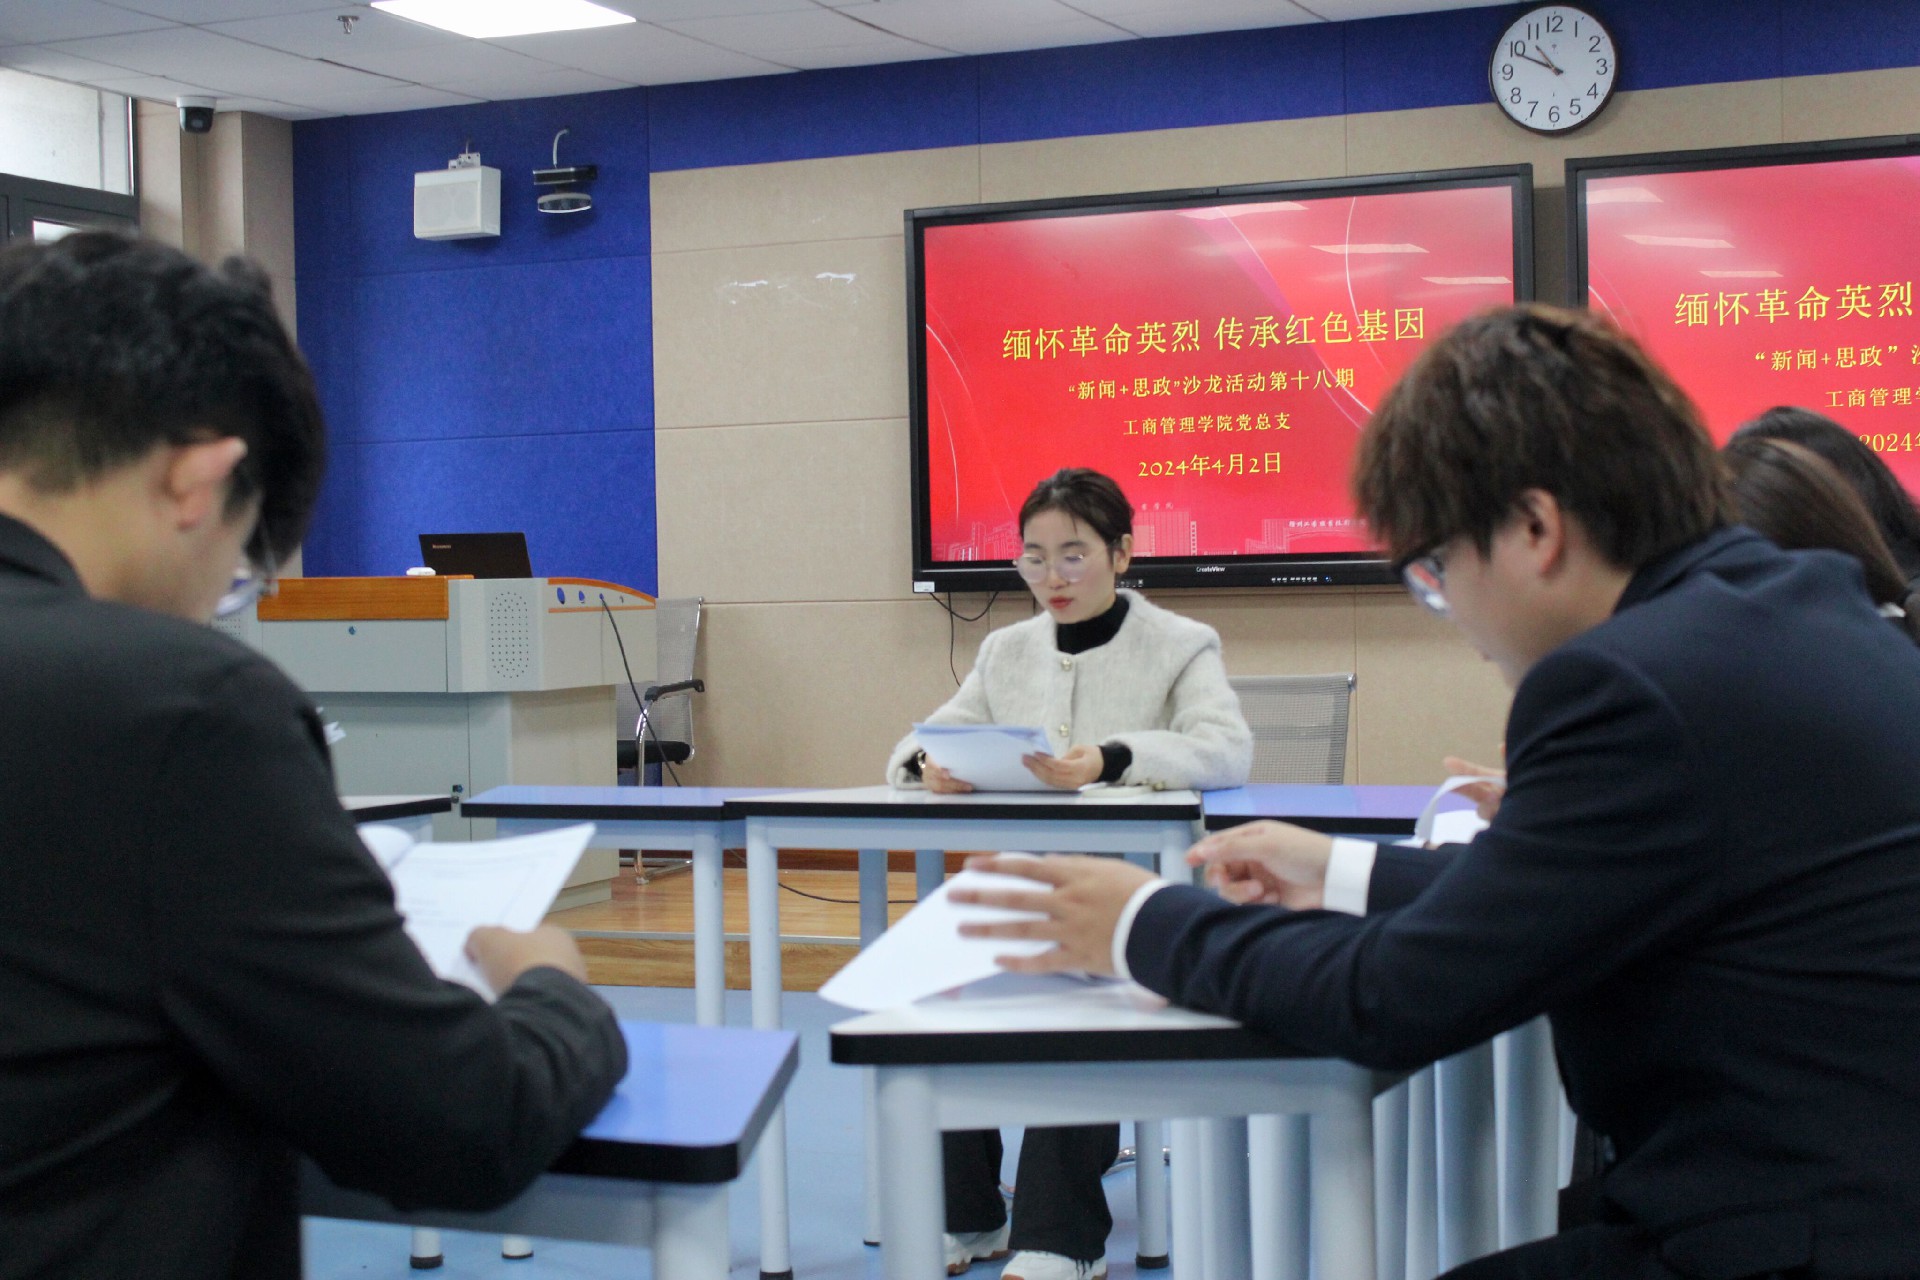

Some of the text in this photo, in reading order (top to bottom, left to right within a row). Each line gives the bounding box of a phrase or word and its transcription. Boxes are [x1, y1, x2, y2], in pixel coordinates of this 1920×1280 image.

[1527, 23, 1539, 40] 11
[1546, 15, 1563, 33] 12
[1510, 40, 1526, 58] 10
[1588, 36, 1601, 52] 2
[1502, 63, 1514, 81] 9
[1596, 58, 1608, 75] 3
[1510, 87, 1522, 104] 8
[1586, 83, 1599, 99] 4
[1527, 101, 1539, 118] 7
[1548, 105, 1560, 123] 6
[1569, 98, 1581, 115] 5
[1674, 281, 1913, 327] 缅怀革命英烈
[1002, 307, 1424, 361] 缅怀革命英烈 传承红色基因
[1825, 387, 1920, 408] 工商管理
[1123, 412, 1291, 436] 工商管理学院党总支
[1859, 432, 1920, 452] 2024
[1138, 452, 1281, 477] 2024年4月2日
